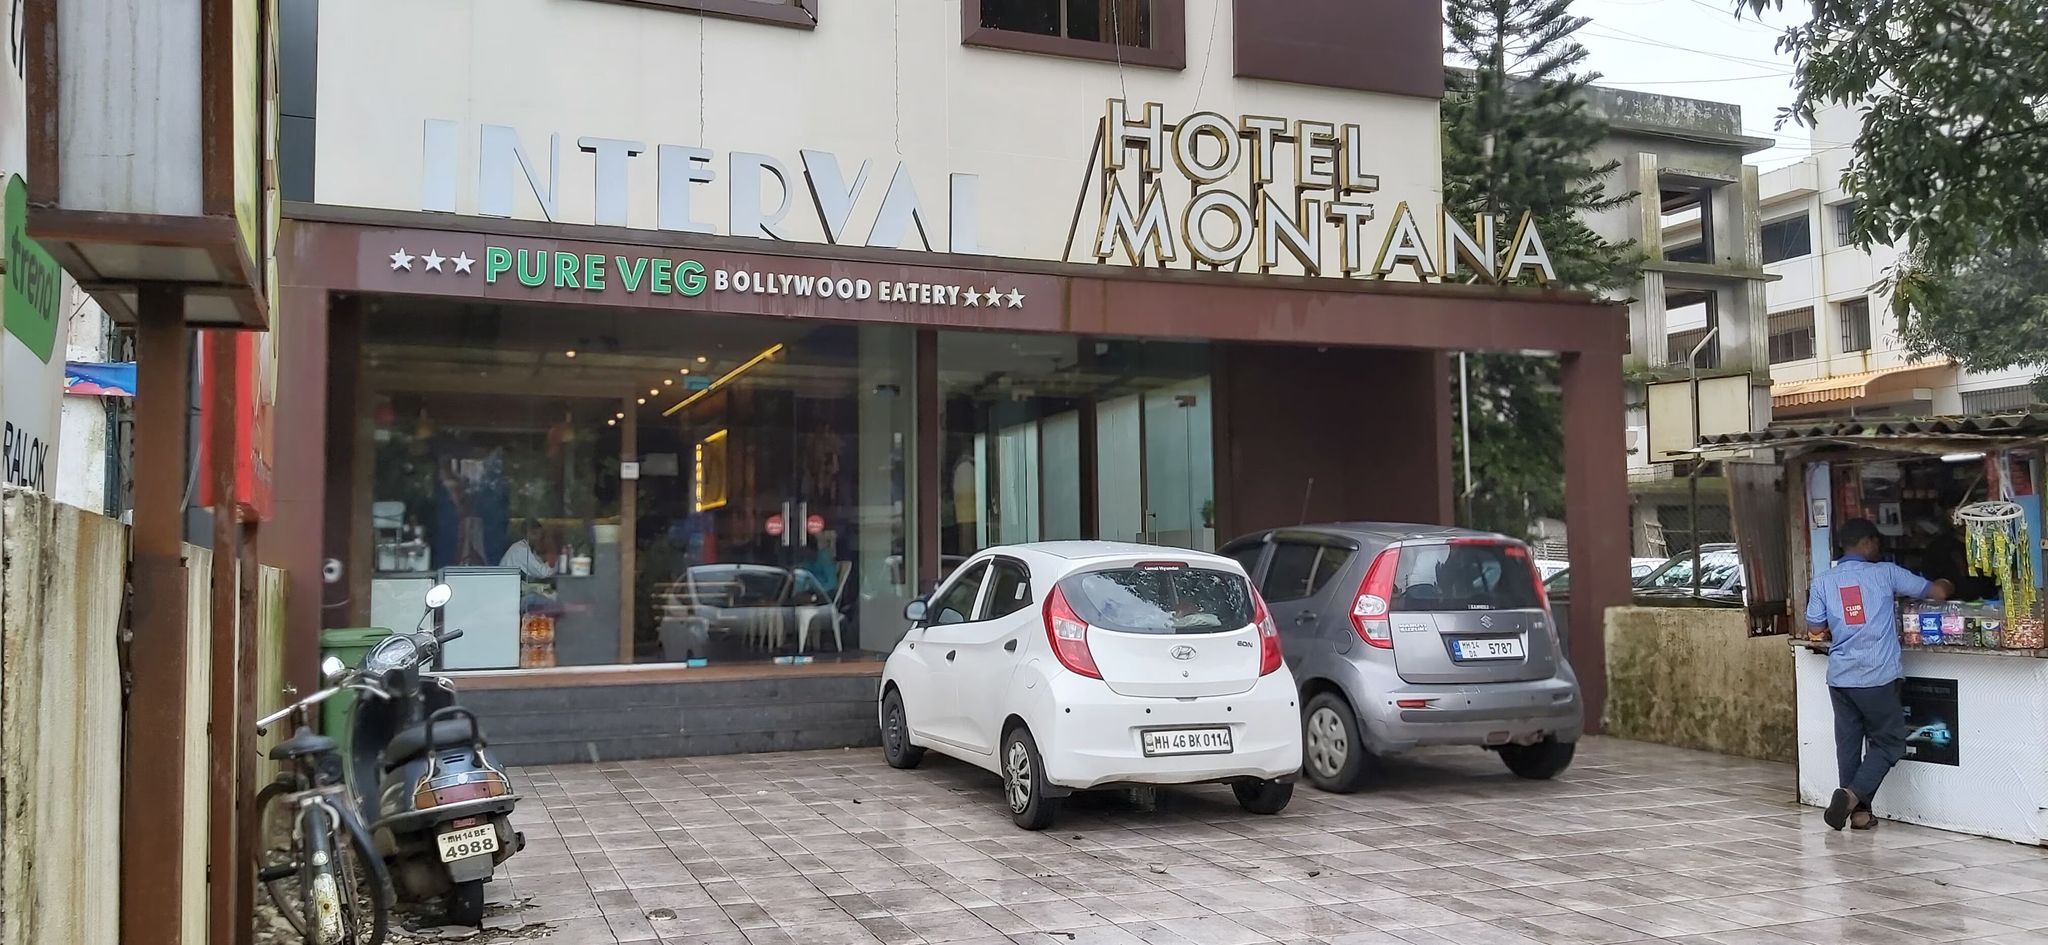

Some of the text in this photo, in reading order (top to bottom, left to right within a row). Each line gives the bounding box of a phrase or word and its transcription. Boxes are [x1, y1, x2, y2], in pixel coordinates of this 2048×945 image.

[1105, 97, 1380, 193] HOTEL
[422, 118, 980, 254] INTERVAL
[1093, 174, 1557, 284] MONTANA
[486, 246, 961, 307] PURE VEG BOLLYWOOD EATERY
[1488, 642, 1512, 655] 5787
[1154, 732, 1229, 749] MH 46 BK 0114
[445, 838, 494, 857] 4988
[447, 828, 487, 843] MH 14 BE
